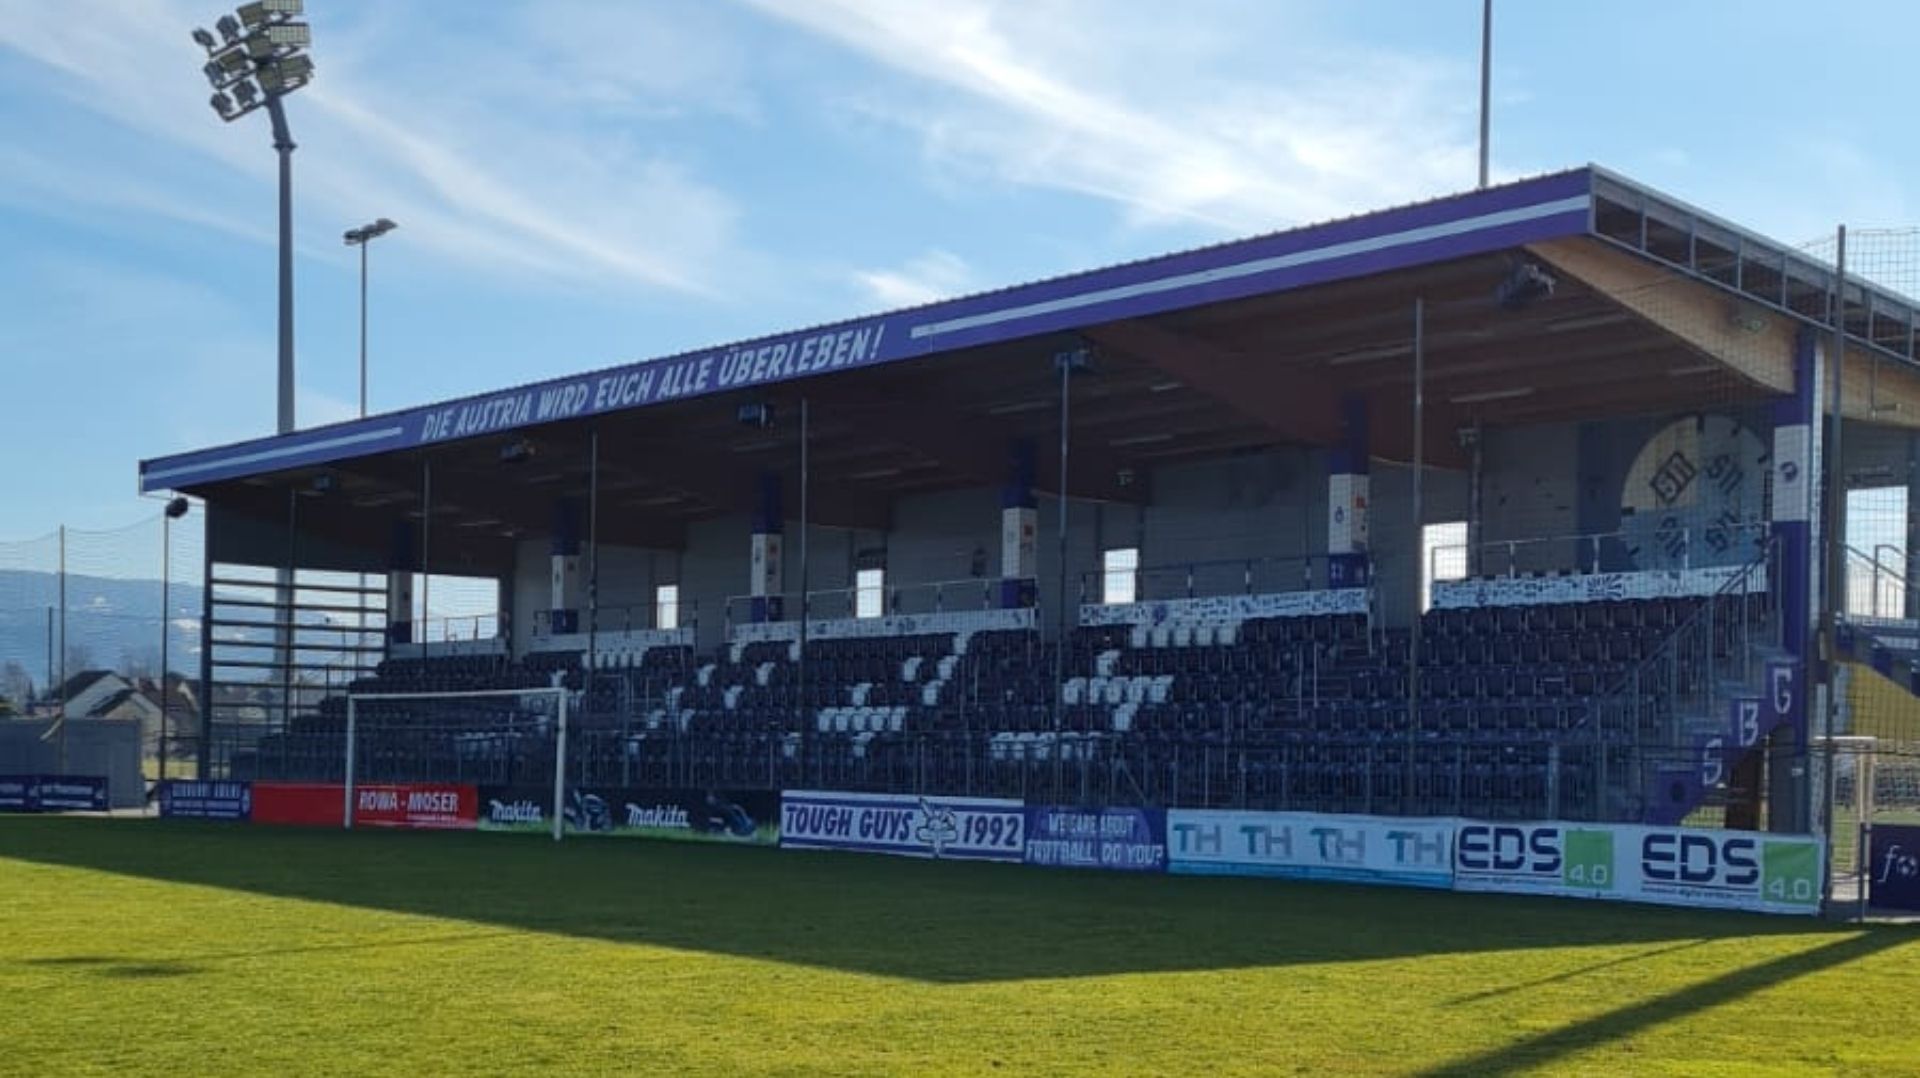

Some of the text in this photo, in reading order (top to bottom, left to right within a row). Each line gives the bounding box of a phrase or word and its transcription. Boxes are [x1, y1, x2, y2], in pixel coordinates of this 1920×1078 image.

[421, 324, 885, 442] DIE AUSTRIA WIRD EUCH ALLE ÜBERLEBEN!
[407, 792, 458, 814] MOSER
[625, 802, 691, 829] makita
[785, 805, 1020, 848] TOUGH GUYS 1992
[1173, 824, 1222, 854] TH
[1239, 825, 1293, 857] TH
[1309, 827, 1366, 864] TH
[1386, 829, 1446, 863] TH
[1458, 825, 1608, 886] EDS 4.0
[1642, 834, 1811, 899] EDS 4.0
